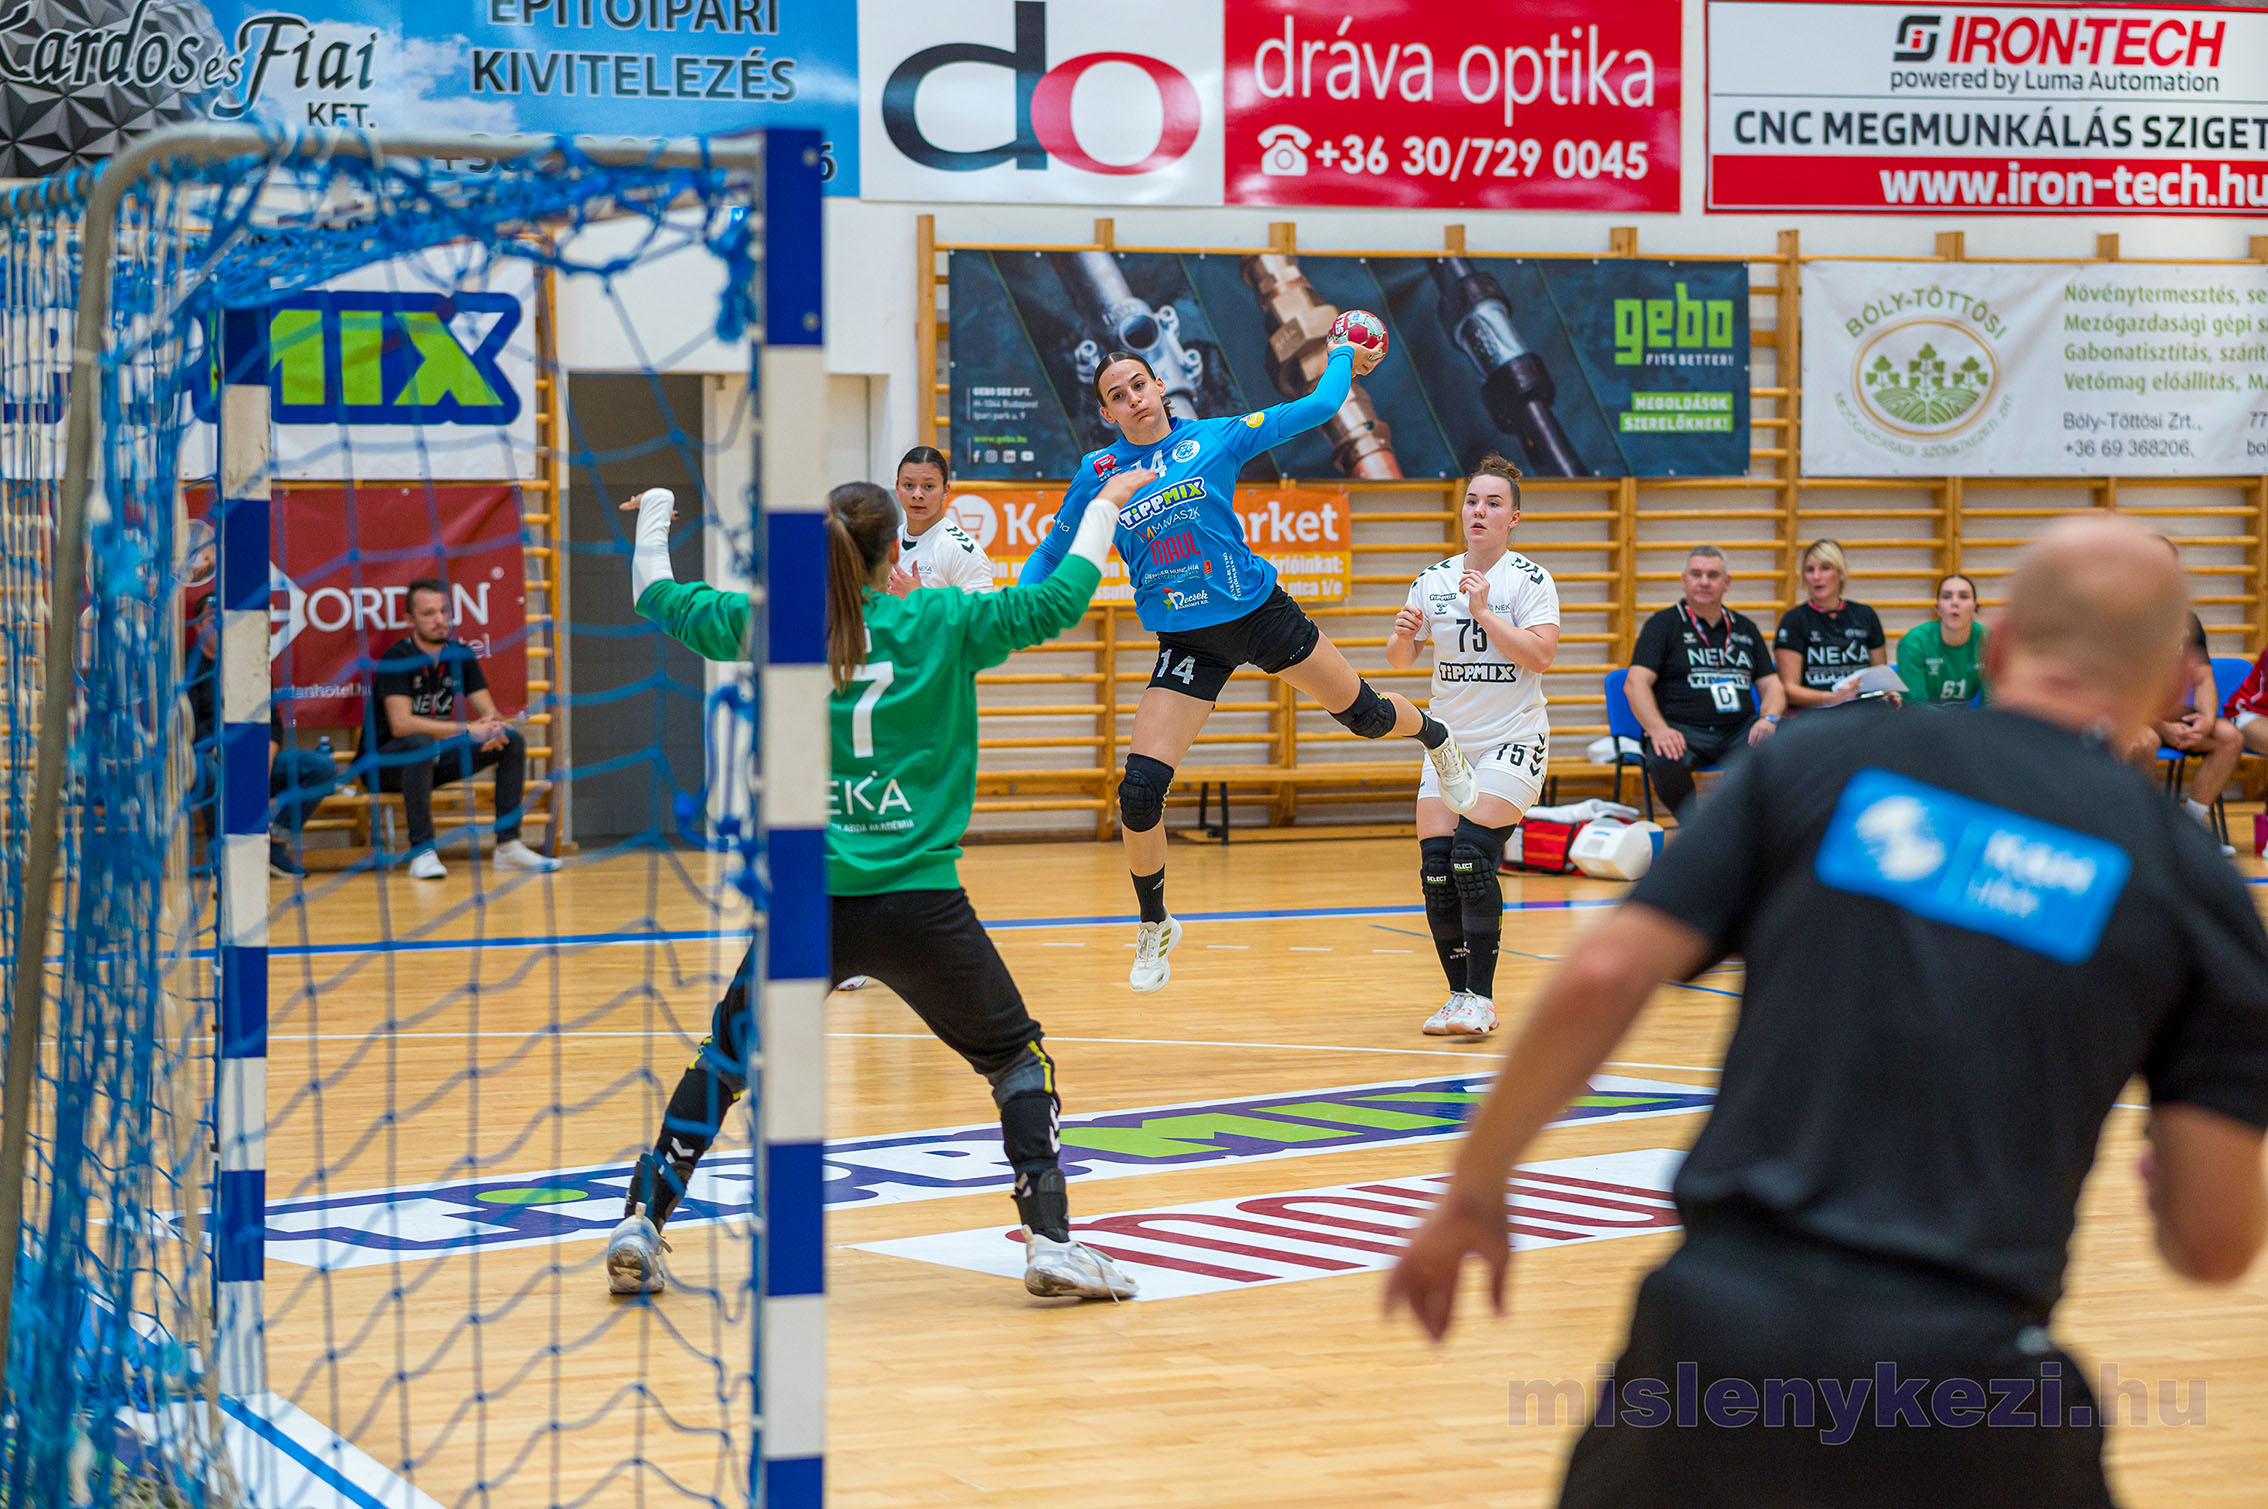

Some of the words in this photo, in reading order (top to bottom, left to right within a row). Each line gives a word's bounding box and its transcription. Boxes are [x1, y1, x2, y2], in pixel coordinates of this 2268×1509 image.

[203, 46, 246, 87] és
[208, 12, 381, 120] Fiai
[471, 47, 798, 101] KIVITELEZÉS
[1254, 14, 1434, 102] dráva
[1457, 24, 1656, 127] optika
[1890, 69, 1991, 93] powered
[1994, 70, 2020, 92] by
[2025, 71, 2083, 92] Luma
[2088, 72, 2220, 93] Automation
[1734, 110, 1813, 146] CNC
[1823, 106, 2133, 149] MEGMUNKÁLÁS
[1314, 134, 1390, 175] +36
[1400, 136, 1542, 182] 30/729
[1552, 140, 1649, 180] 0045
[1879, 162, 2268, 206] www.iron-tech.hu
[2247, 288, 2268, 304] se
[1613, 282, 1734, 365] gebo
[1149, 530, 1202, 566] MAUL
[1455, 618, 1488, 653] 75
[1156, 648, 1197, 685] 14
